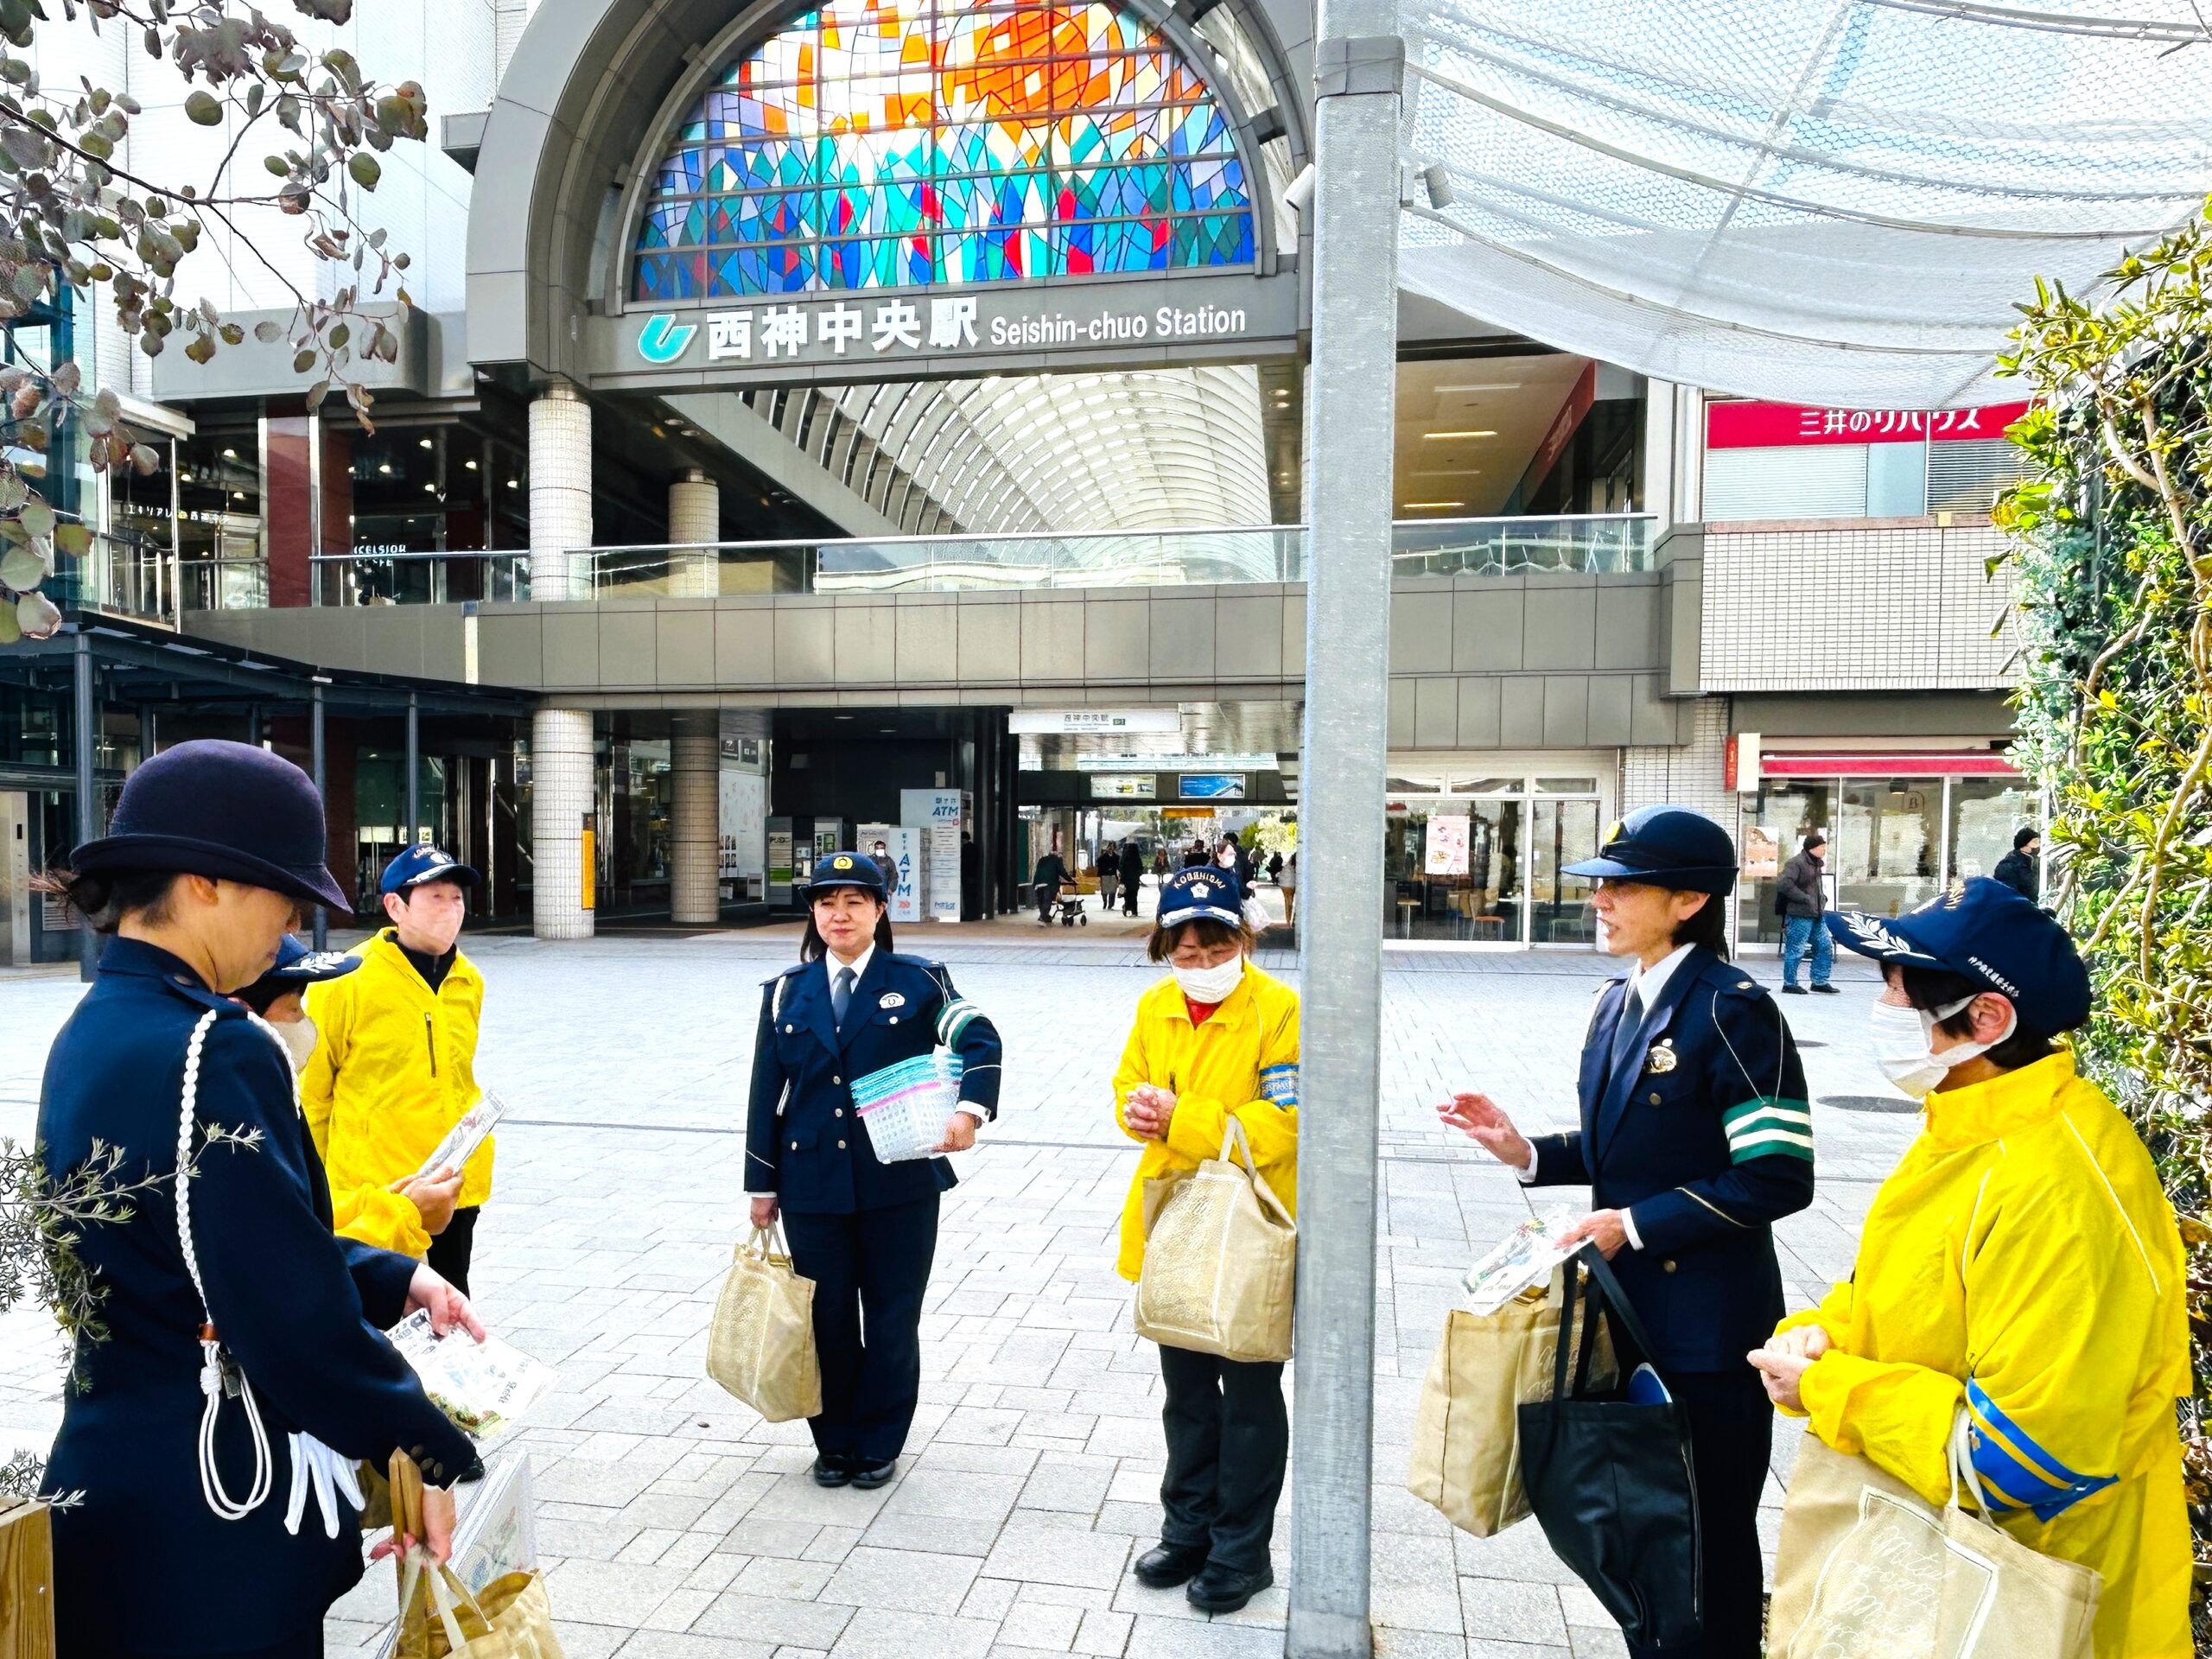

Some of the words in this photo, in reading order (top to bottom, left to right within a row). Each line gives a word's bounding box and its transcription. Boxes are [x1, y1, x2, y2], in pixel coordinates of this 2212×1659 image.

[706, 296, 979, 359] 西神中央駅
[990, 311, 1147, 346] Seishin-chuo
[1155, 305, 1246, 336] Station
[1800, 409, 1980, 435] 三井のリハウス
[932, 806, 958, 816] ATM
[897, 853, 912, 896] ATM
